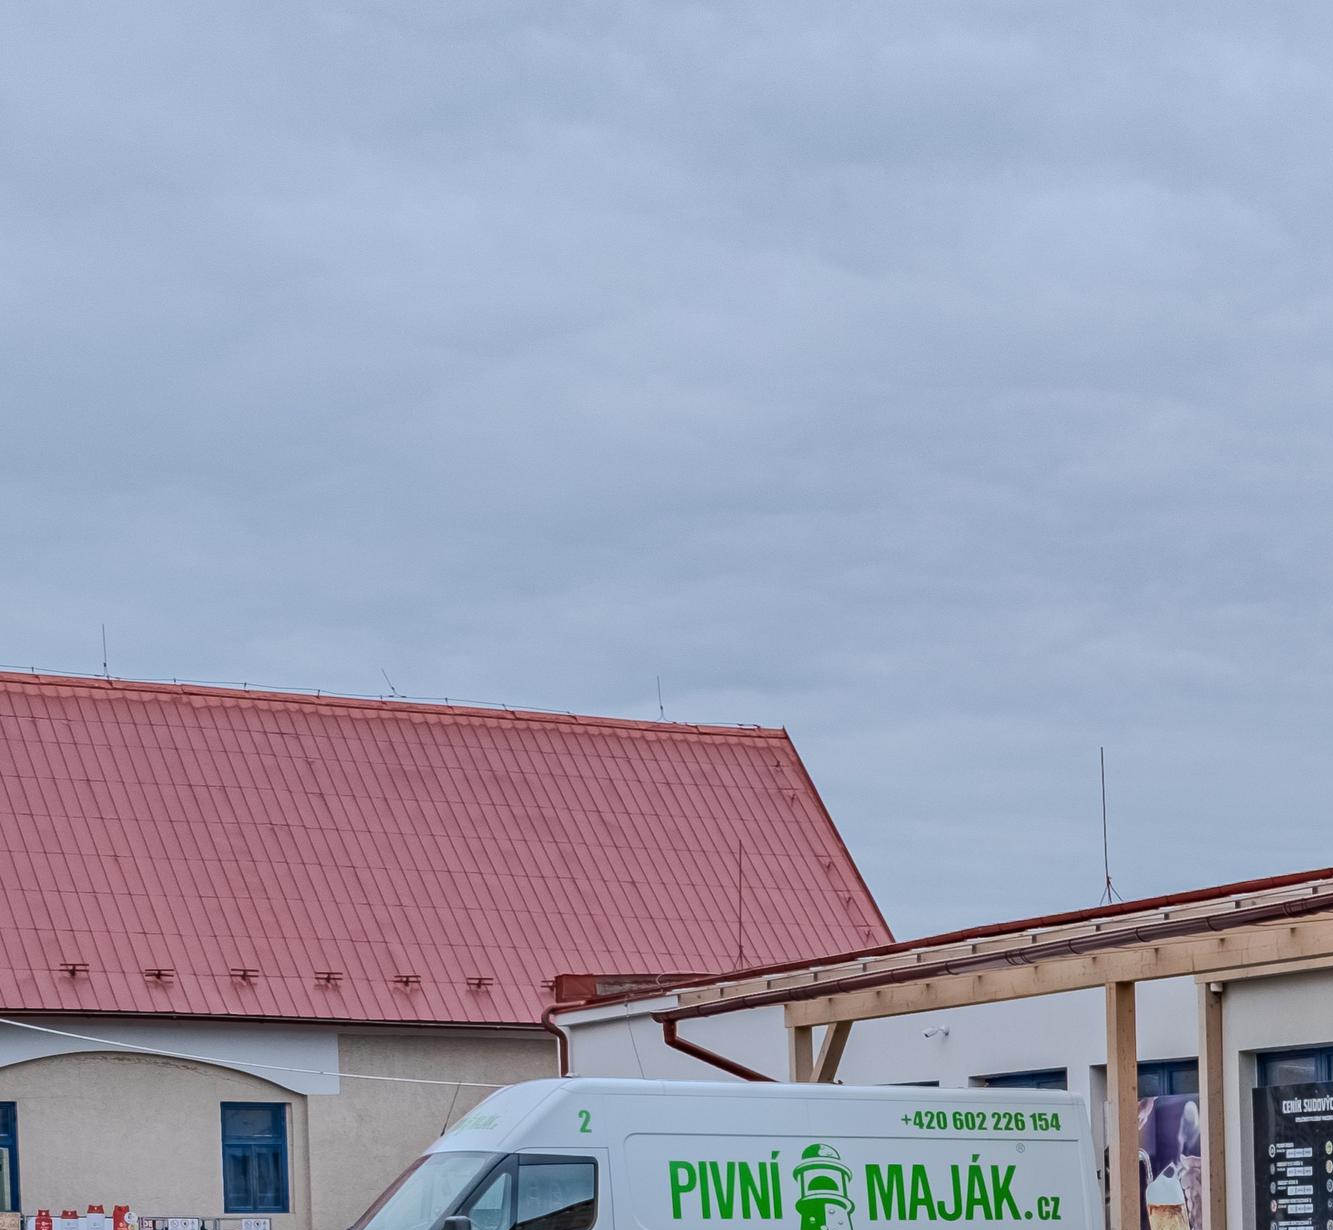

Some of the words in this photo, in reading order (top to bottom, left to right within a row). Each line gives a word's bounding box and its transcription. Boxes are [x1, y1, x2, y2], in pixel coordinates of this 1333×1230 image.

[578, 1109, 592, 1133] 2
[901, 1111, 948, 1130] +420
[952, 1111, 987, 1130] 602
[991, 1112, 1025, 1131] 226
[1029, 1113, 1061, 1131] 154
[669, 1151, 783, 1219] PIVNÍ
